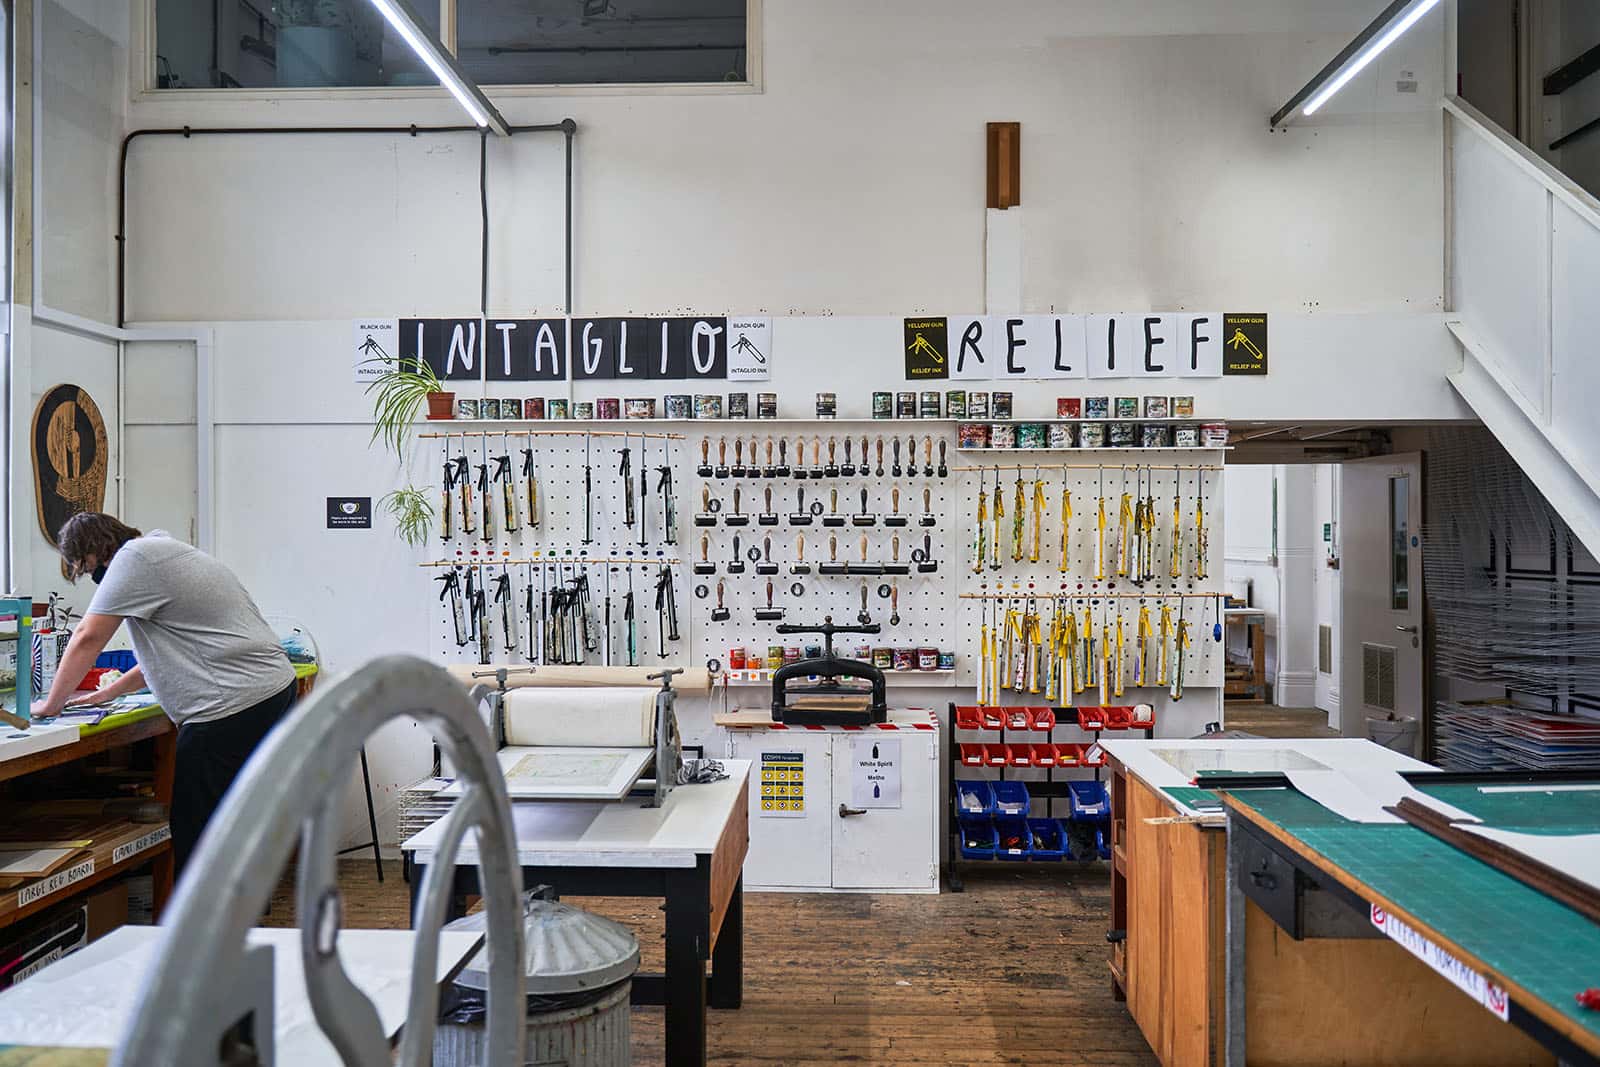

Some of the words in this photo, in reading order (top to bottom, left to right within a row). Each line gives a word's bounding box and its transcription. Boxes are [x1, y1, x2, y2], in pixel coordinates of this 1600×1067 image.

[416, 320, 722, 376] INTAGLIO
[957, 317, 1210, 374] RELIEF
[20, 886, 46, 905] LARGE
[49, 875, 65, 891] REG
[68, 862, 93, 884] BOARDS
